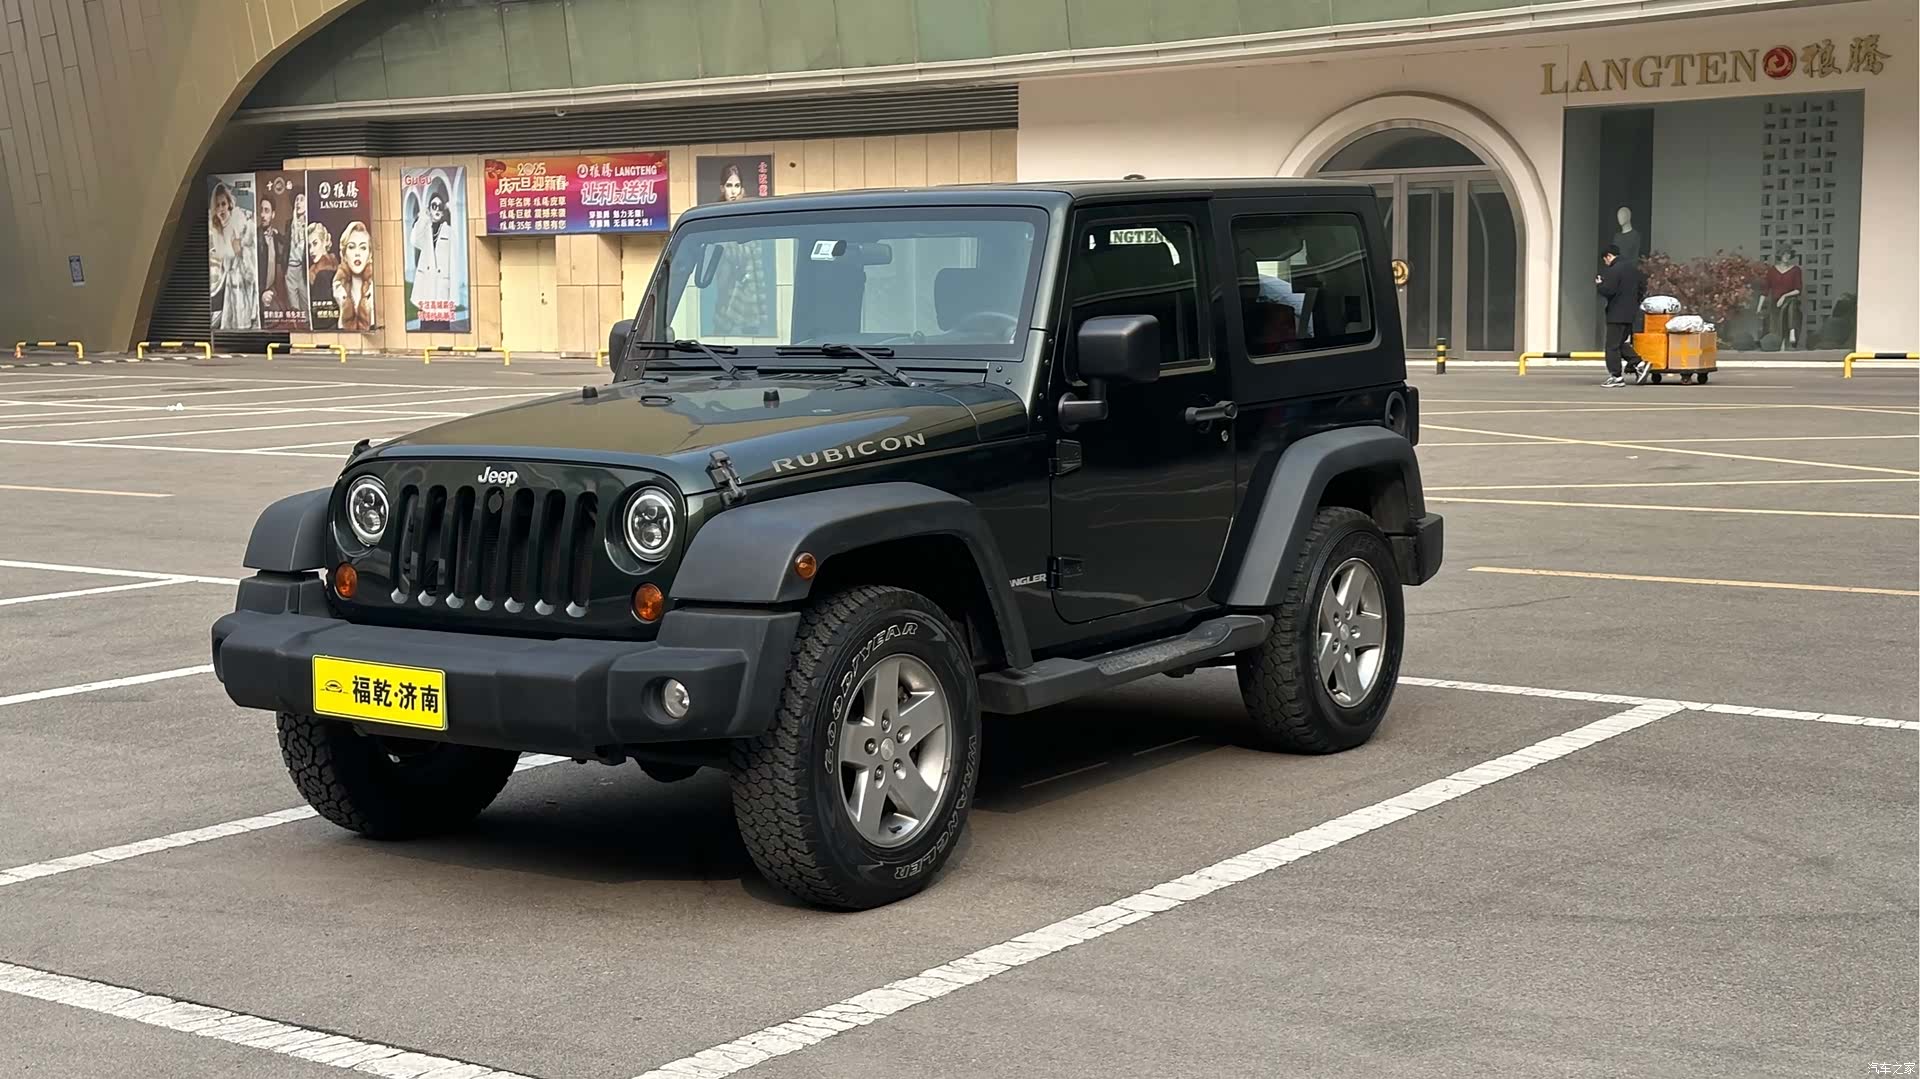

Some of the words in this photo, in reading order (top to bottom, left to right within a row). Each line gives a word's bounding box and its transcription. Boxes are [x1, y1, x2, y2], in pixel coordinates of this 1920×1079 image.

[1540, 49, 1760, 95] LANGTEN
[517, 163, 547, 176] 2025
[614, 165, 657, 177] LANGTENG
[495, 175, 569, 195] 庆元旦迎新春
[319, 200, 359, 210] LANGTENG
[771, 432, 926, 472] RUBICON
[477, 465, 519, 488] Jeep
[1008, 573, 1048, 588] NGLER
[825, 622, 919, 775] GOODYEAR
[893, 734, 977, 880] WRANGLER
